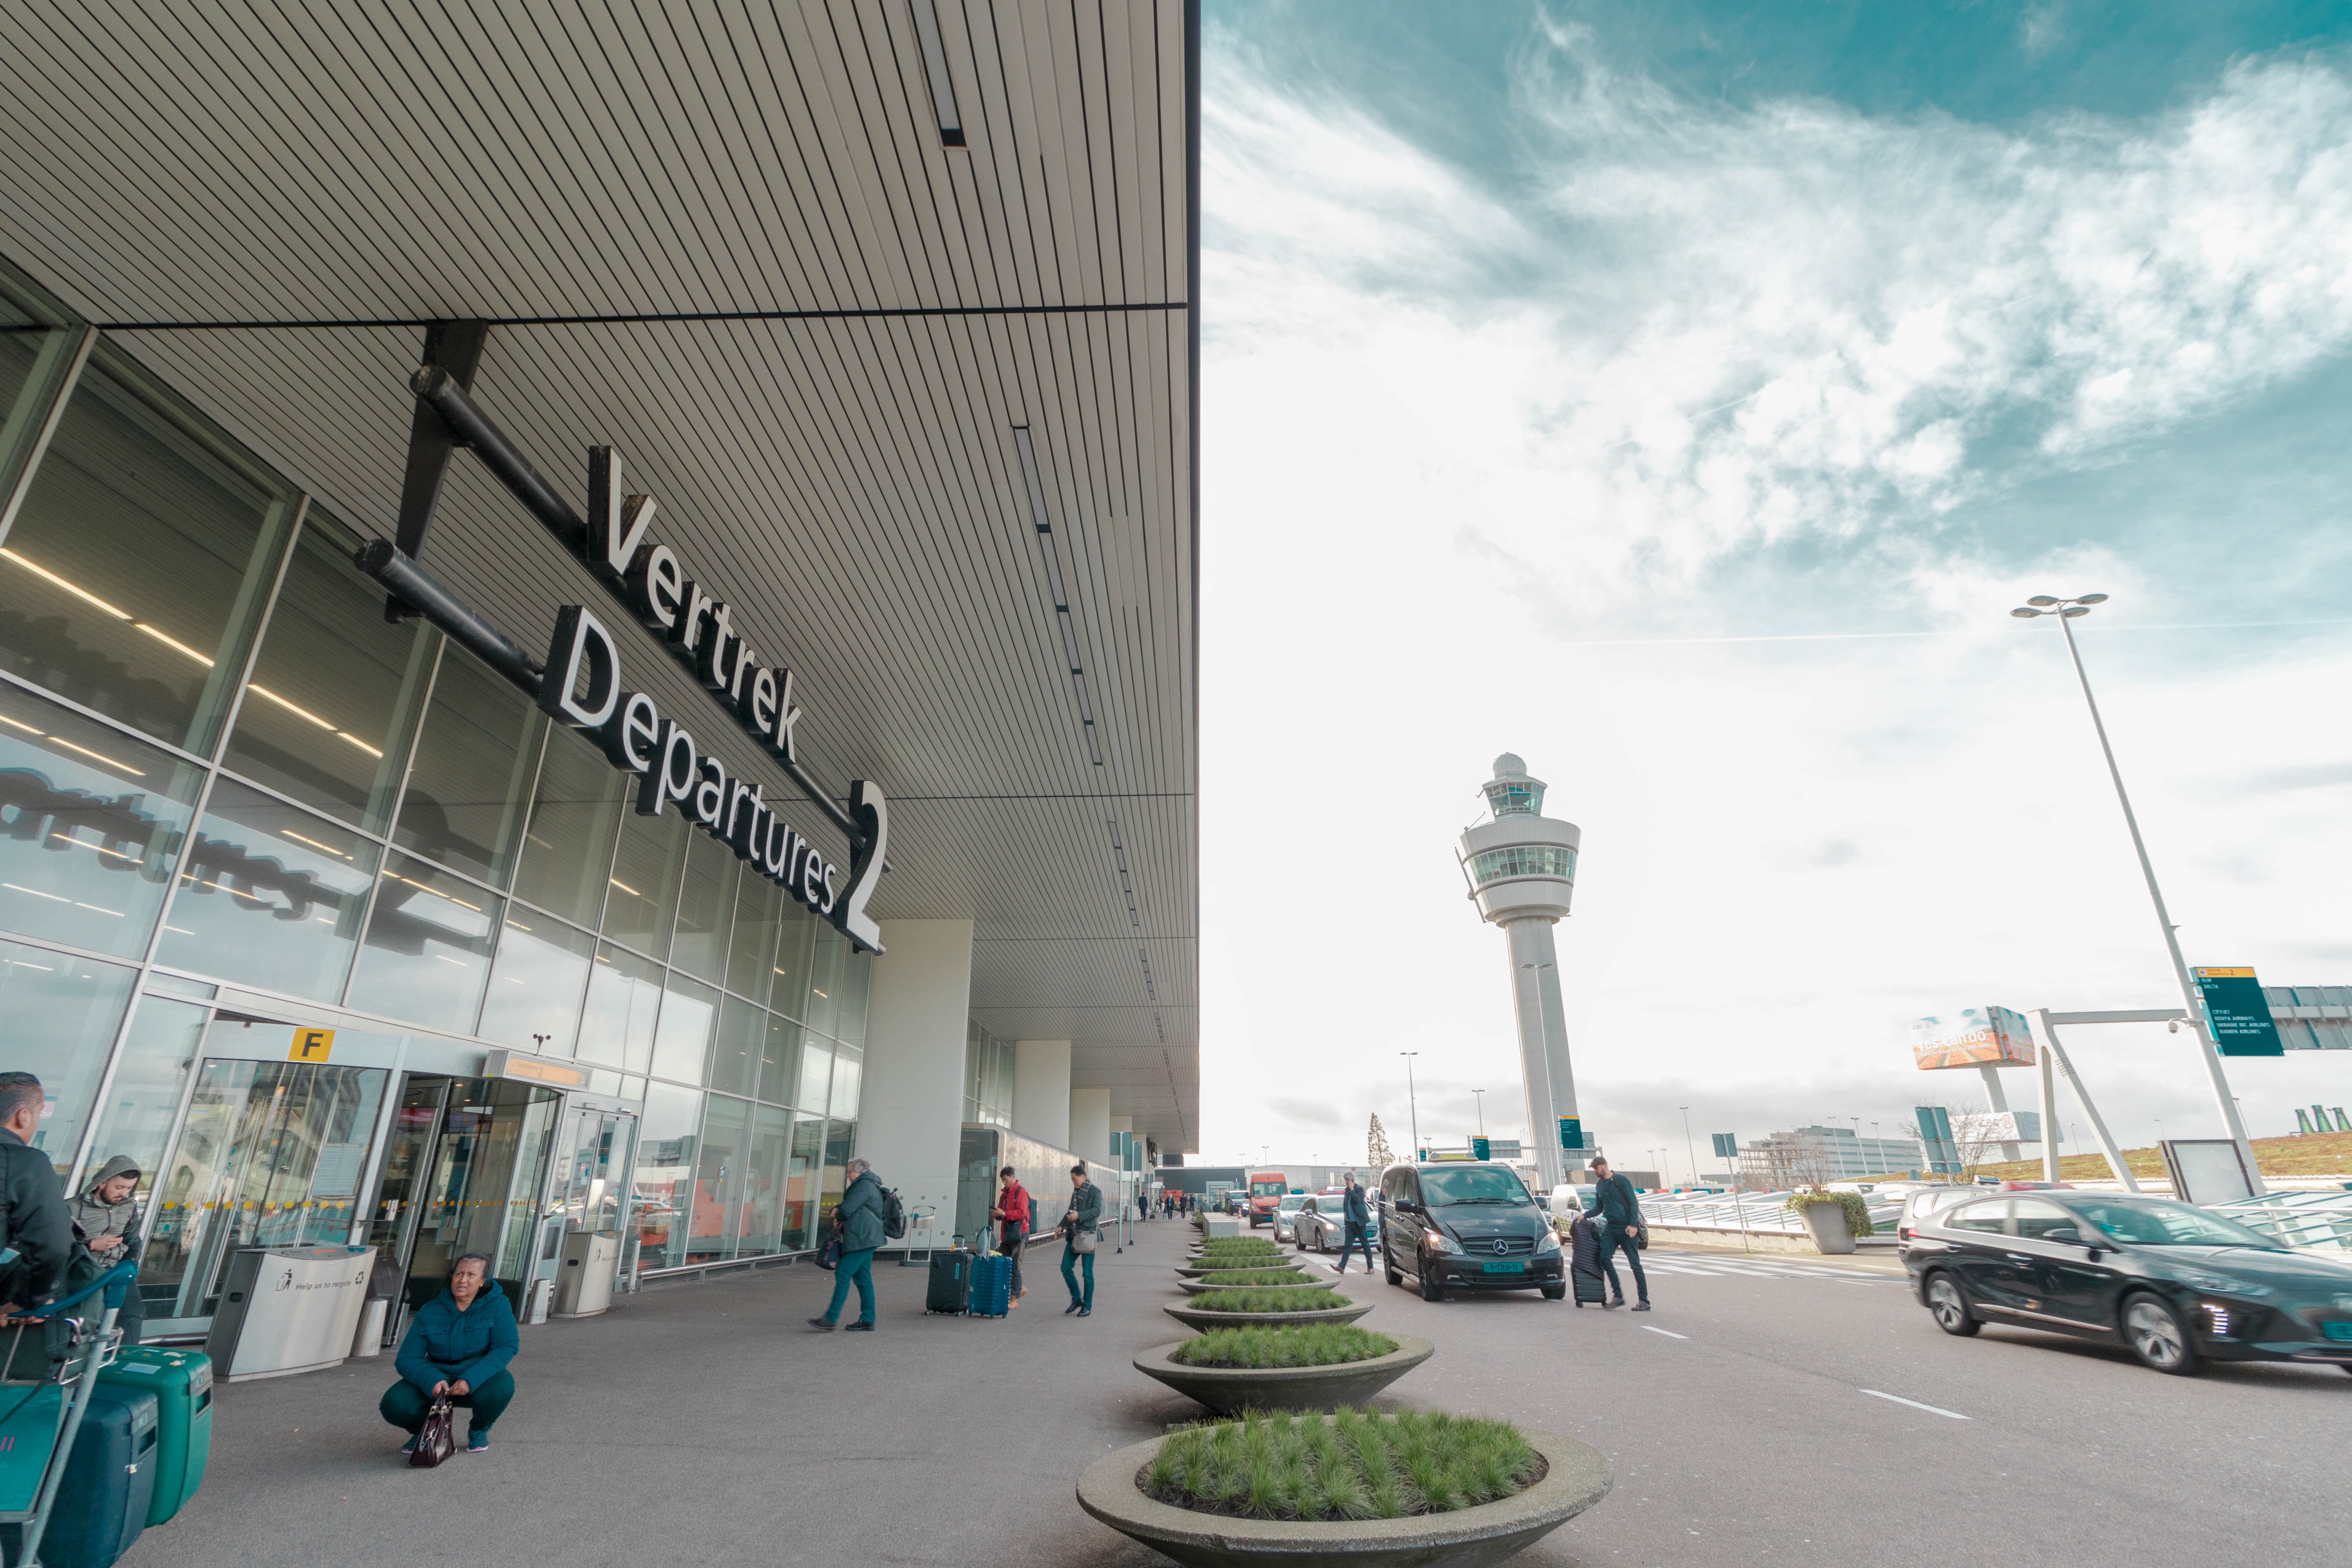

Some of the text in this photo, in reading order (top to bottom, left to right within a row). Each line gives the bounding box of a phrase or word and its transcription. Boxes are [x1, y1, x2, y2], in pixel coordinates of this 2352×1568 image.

[589, 445, 801, 764] Vertrek
[543, 605, 887, 952] Departures 2
[301, 1033, 324, 1057] F
[538, 1067, 544, 1077] 2
[332, 1279, 352, 1289] recycle
